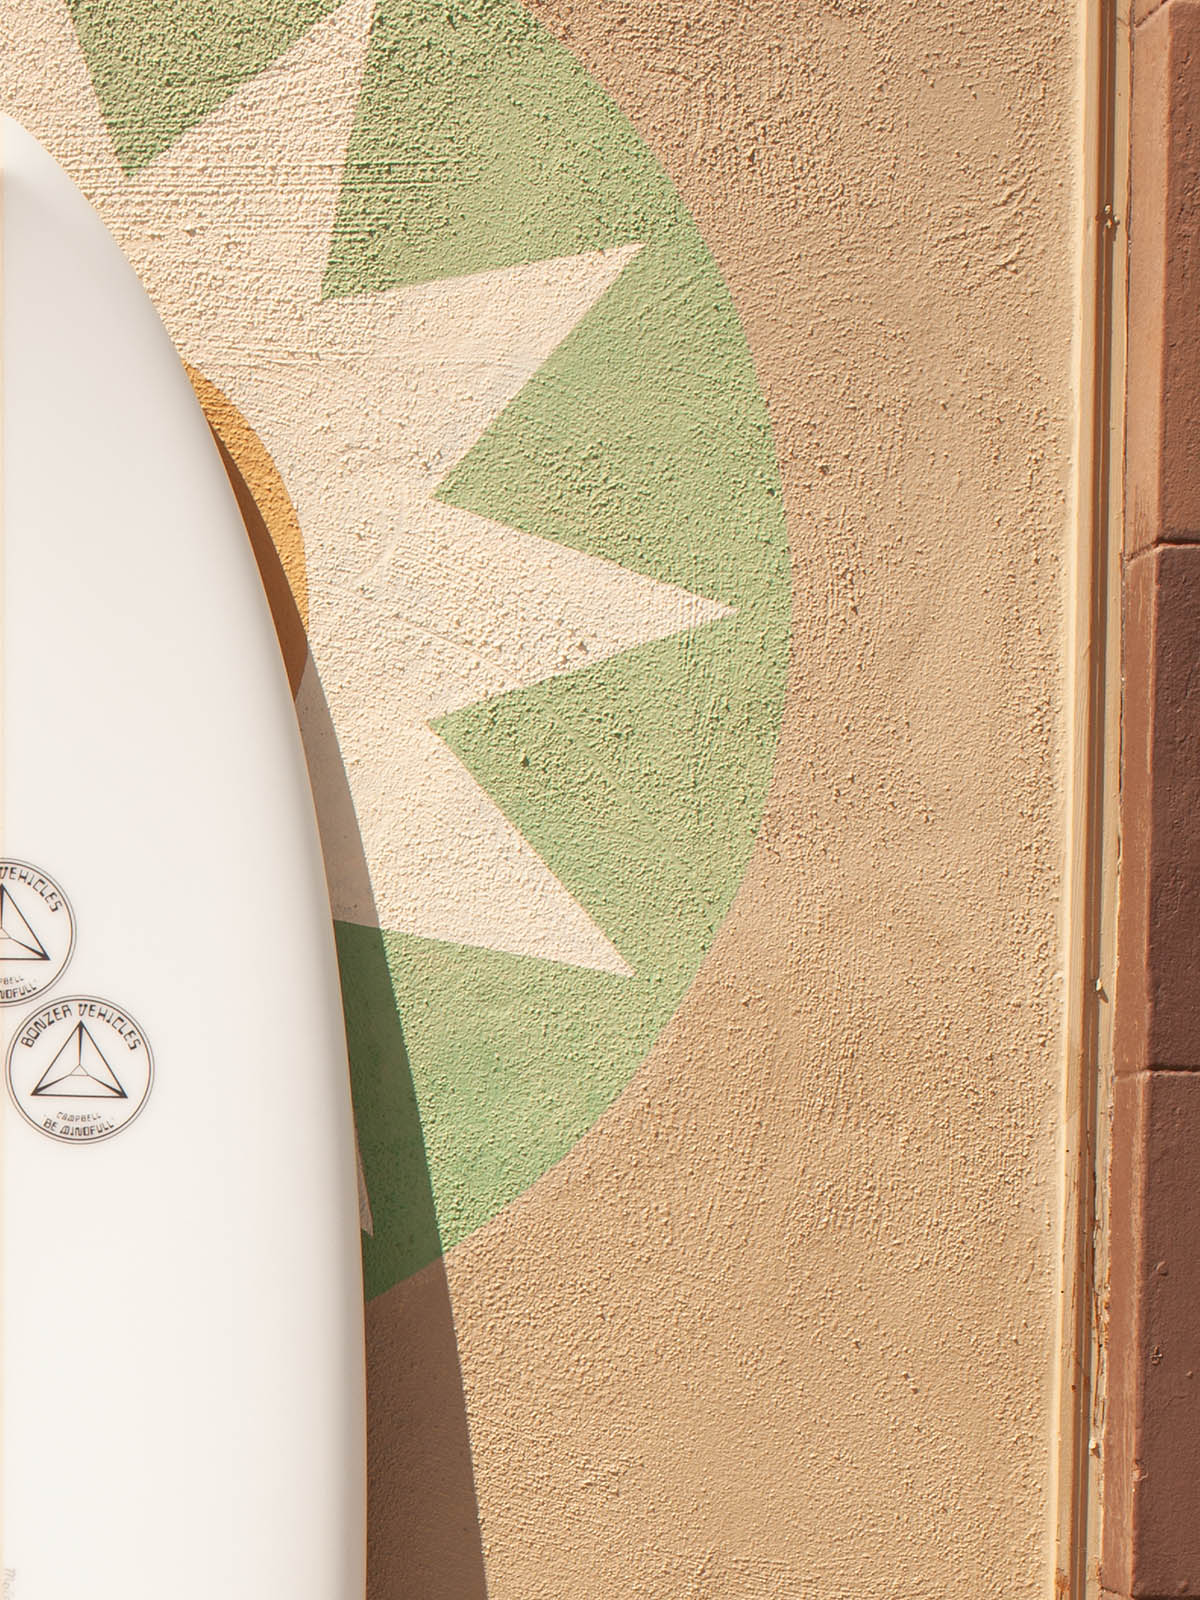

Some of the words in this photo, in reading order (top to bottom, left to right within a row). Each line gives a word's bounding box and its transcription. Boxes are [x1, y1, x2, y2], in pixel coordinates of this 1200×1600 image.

[20, 1004, 73, 1048] BONZER
[78, 1003, 142, 1051] VEHICLES
[43, 1118, 58, 1132] BE
[60, 1120, 115, 1136] MINDFULL
